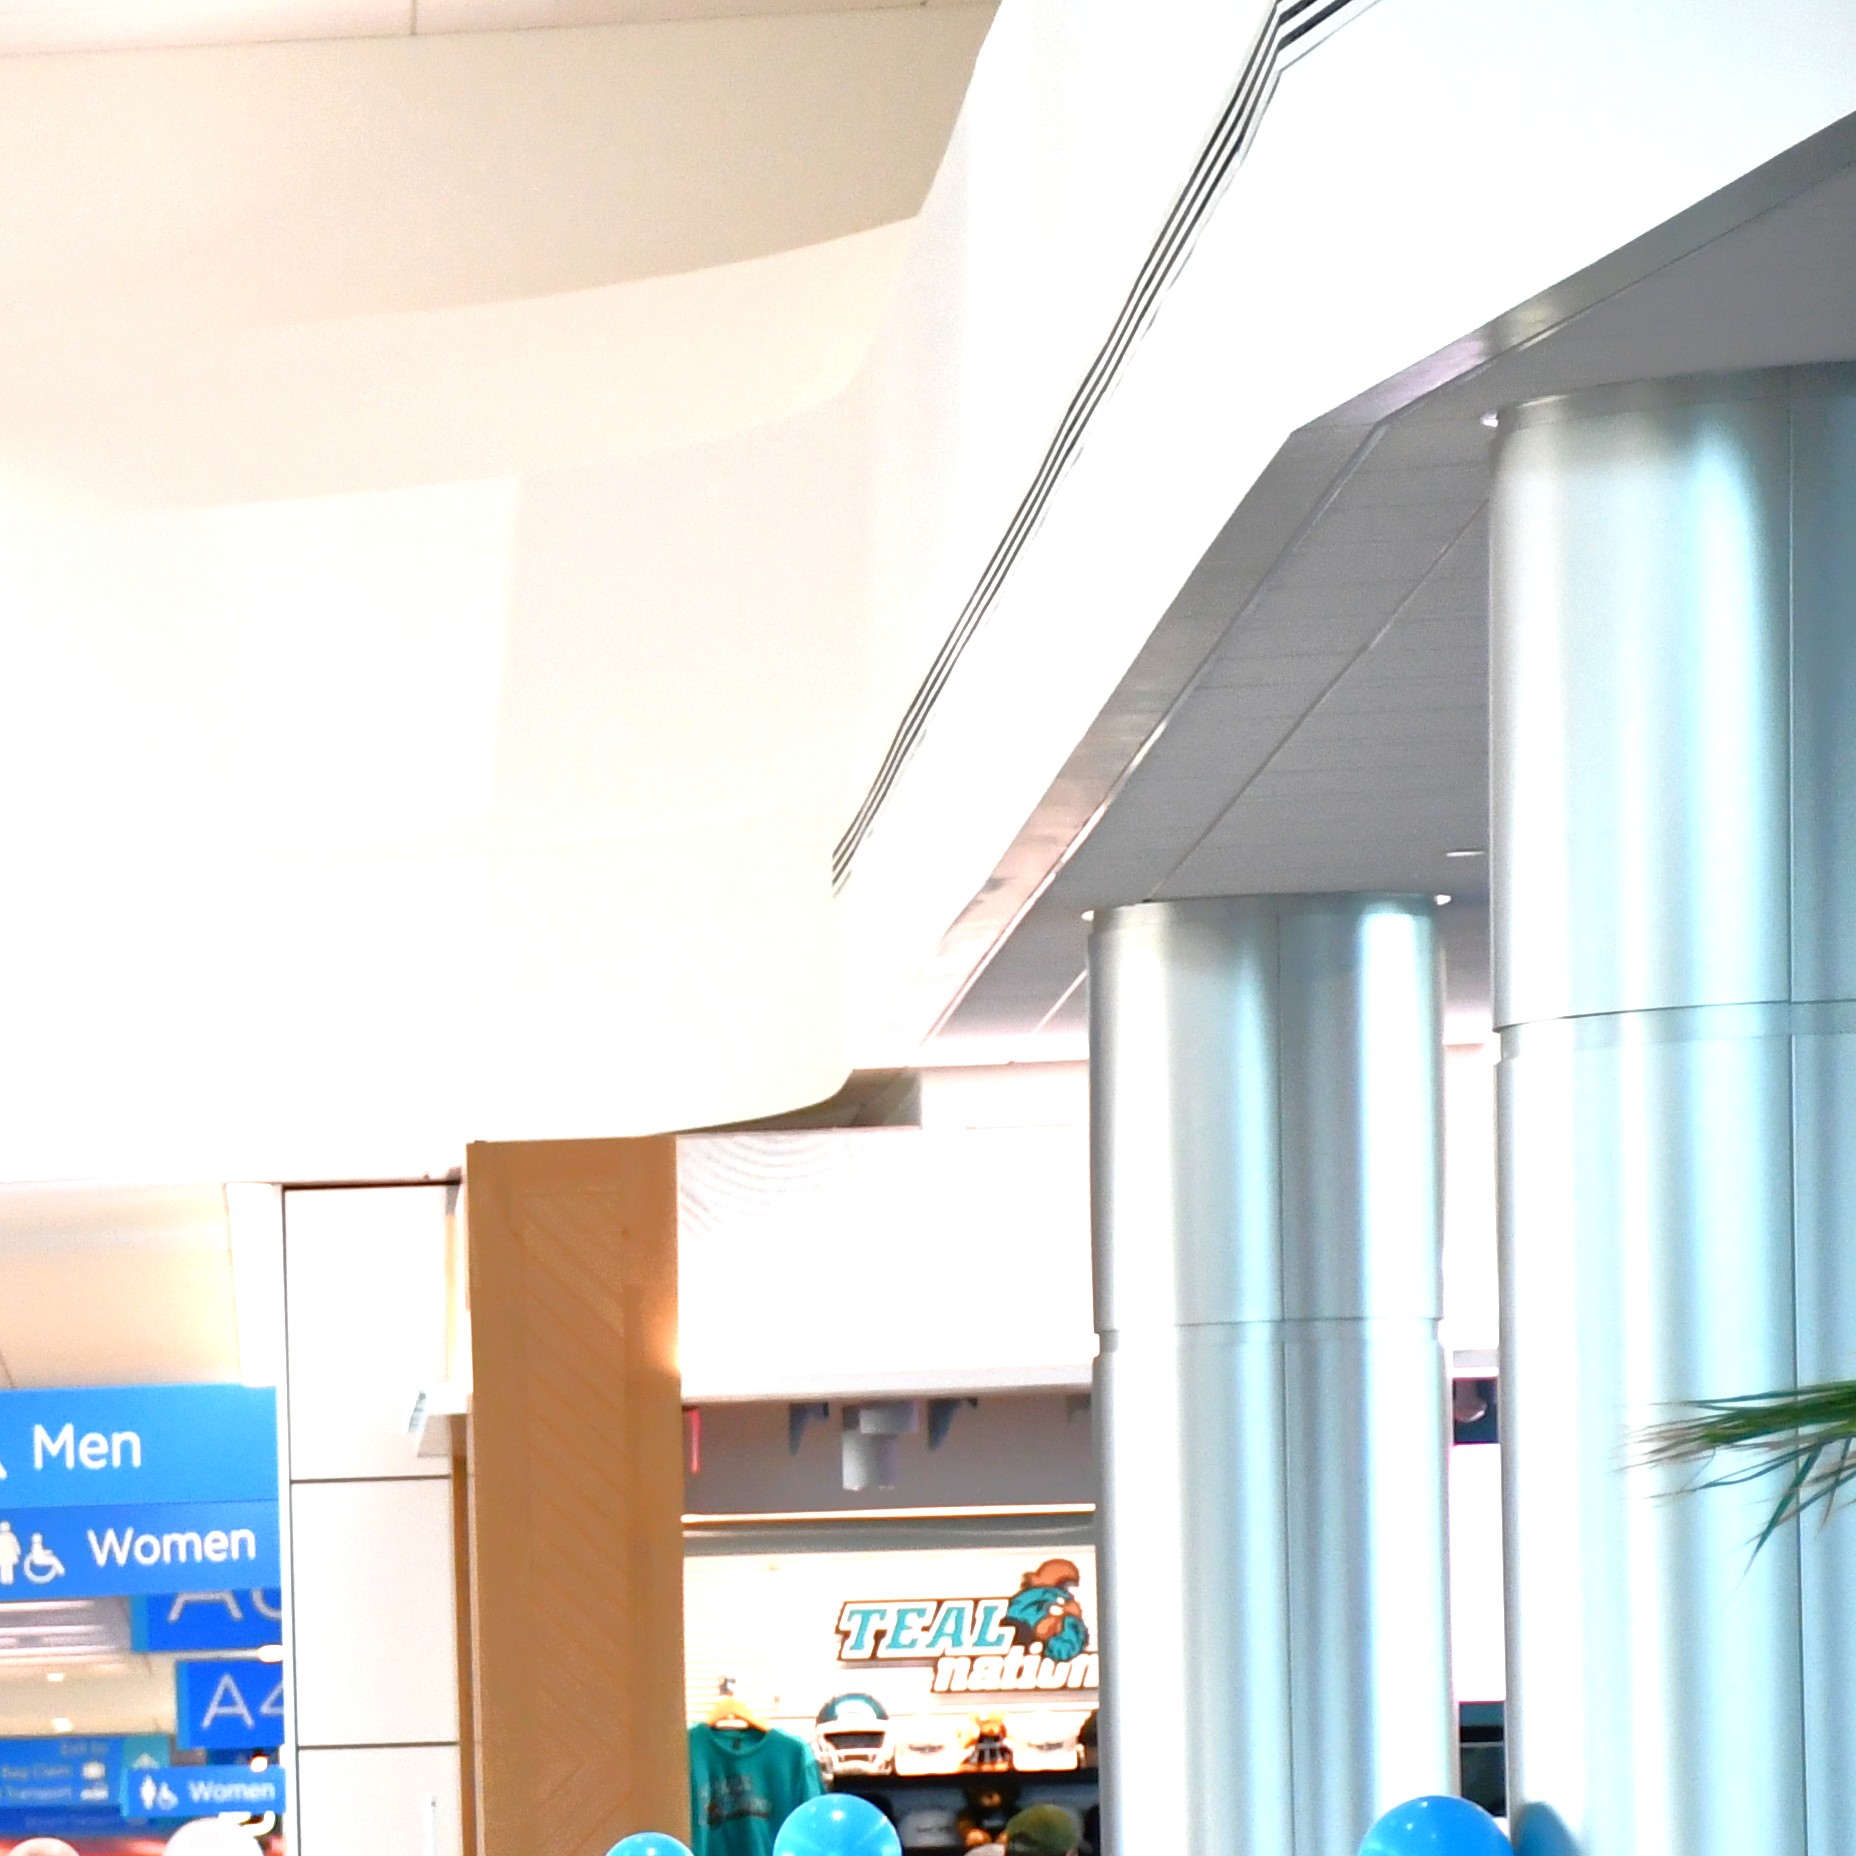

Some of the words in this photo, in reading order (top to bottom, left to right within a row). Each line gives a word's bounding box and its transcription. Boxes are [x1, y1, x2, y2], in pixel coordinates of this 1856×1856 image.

[33, 1422, 142, 1471] Men
[86, 1526, 257, 1568] Women
[841, 1601, 1013, 1656] TEAL
[932, 1642, 1100, 1692] nation
[187, 1780, 276, 1803] Women
